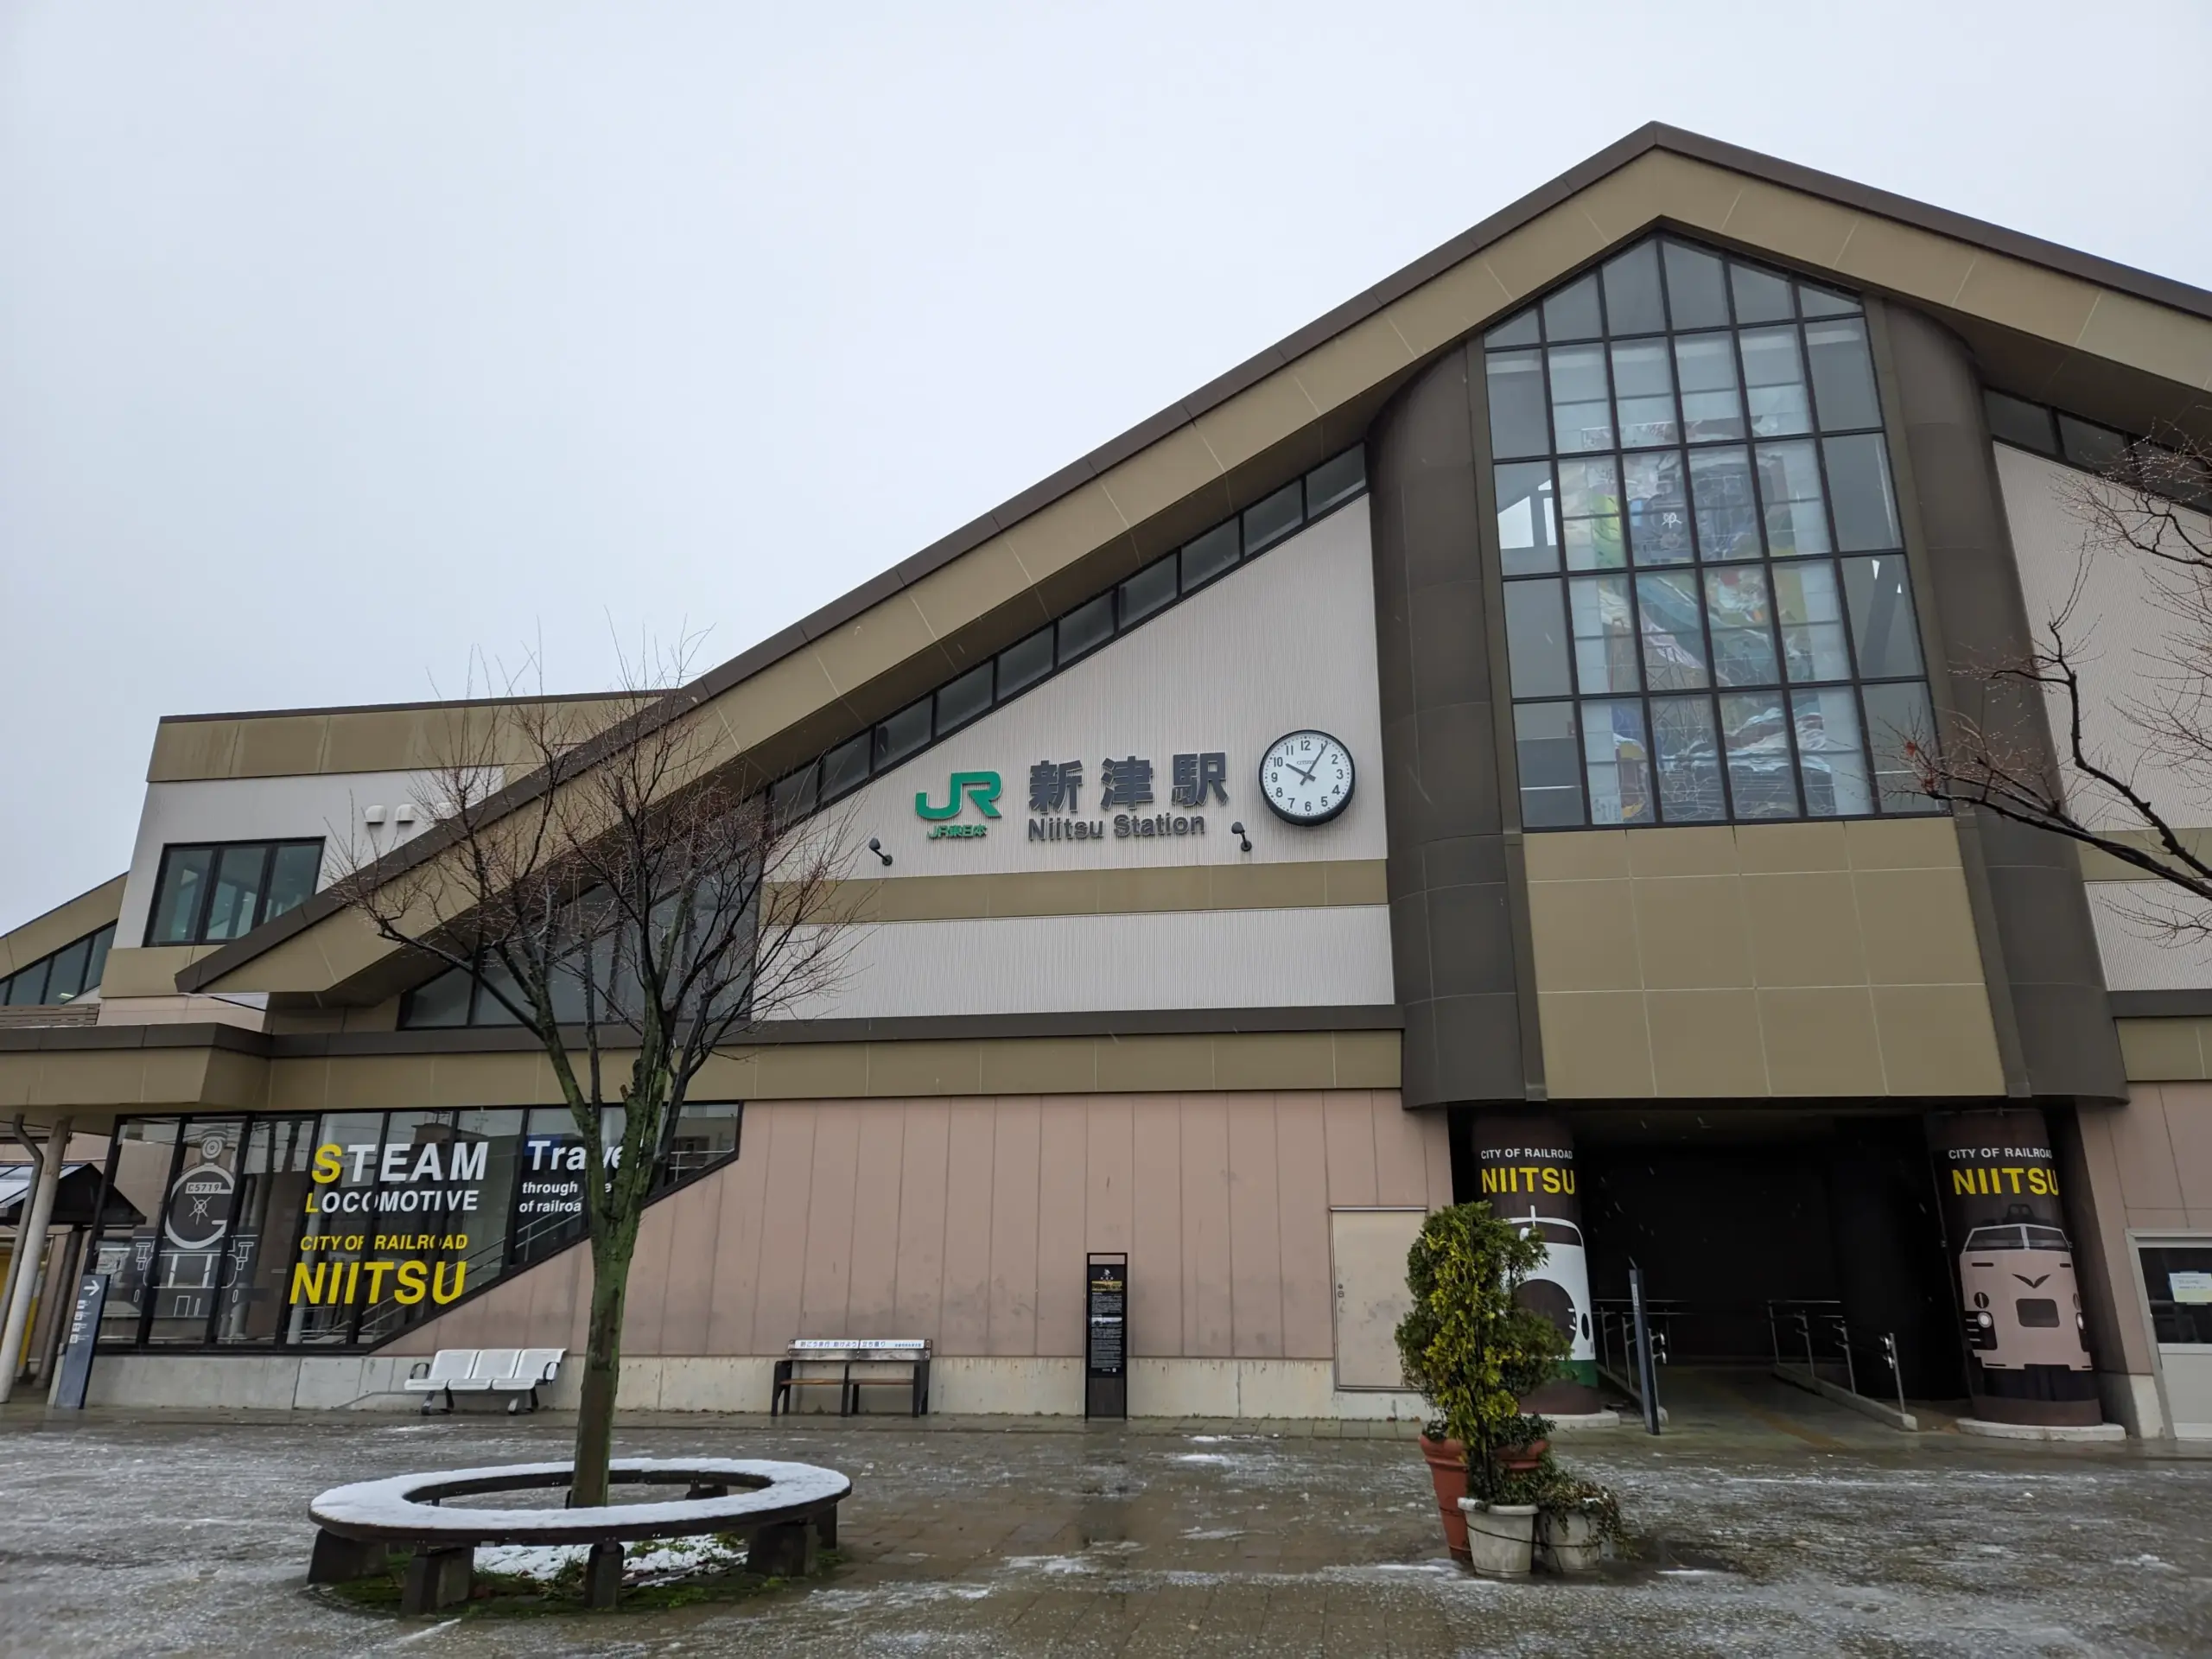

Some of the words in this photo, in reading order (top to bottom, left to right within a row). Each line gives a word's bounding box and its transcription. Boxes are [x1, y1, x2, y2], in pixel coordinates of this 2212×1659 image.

[1286, 745, 1294, 756] 11
[1300, 740, 1311, 751] 12
[1274, 756, 1283, 767] 10
[1332, 753, 1338, 765] 2
[1270, 772, 1278, 783] 9
[1336, 768, 1344, 780] 3
[1028, 752, 1229, 814] 新津駅
[915, 771, 1002, 820] JR
[1275, 786, 1283, 798] 8
[1332, 784, 1340, 796] 4
[1287, 798, 1295, 809] 7
[1305, 801, 1312, 812] 6
[1320, 796, 1328, 808] 5
[927, 824, 988, 839] JR東日本
[1028, 817, 1103, 841] Niitsu
[1114, 813, 1205, 837] Station
[528, 1139, 643, 1171] Trave
[1481, 1149, 1502, 1160] CITY
[1505, 1148, 1521, 1158] OF
[1524, 1148, 1573, 1160] RAILROAD
[1948, 1149, 1976, 1159] CITY
[1980, 1147, 1999, 1158] OF
[311, 1142, 489, 1184] STEAM
[1481, 1167, 1575, 1195] NIITSU
[1952, 1167, 2059, 1196] NIITSU
[188, 1183, 221, 1192] C5719
[522, 1180, 578, 1196] through
[305, 1190, 479, 1213] LOCOMOTIVE
[518, 1200, 535, 1213] of
[300, 1236, 341, 1251] CITY
[289, 1261, 467, 1305] NIITSU
